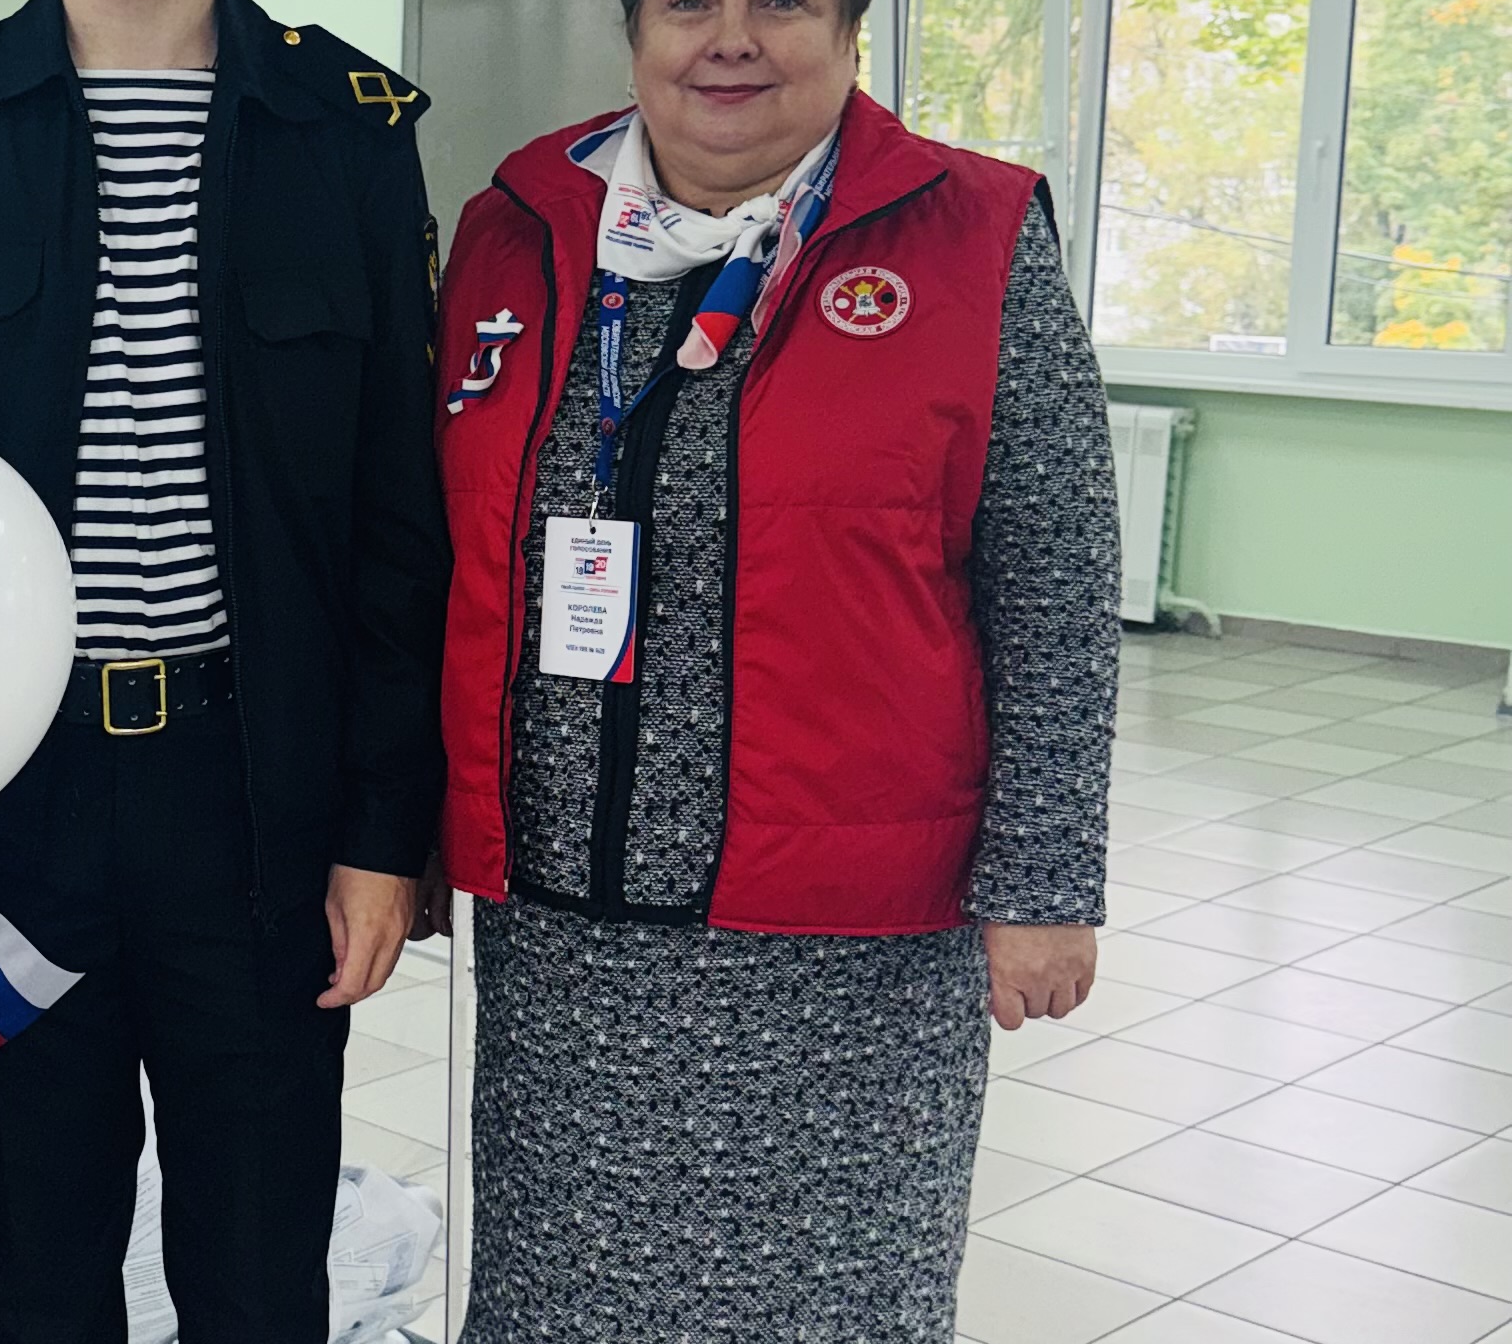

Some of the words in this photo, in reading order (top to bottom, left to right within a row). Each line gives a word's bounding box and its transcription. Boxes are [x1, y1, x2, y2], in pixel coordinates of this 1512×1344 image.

[567, 603, 607, 614] КОРОЛЕВА
[570, 614, 603, 624] Надежда
[569, 624, 604, 635] Петровна
